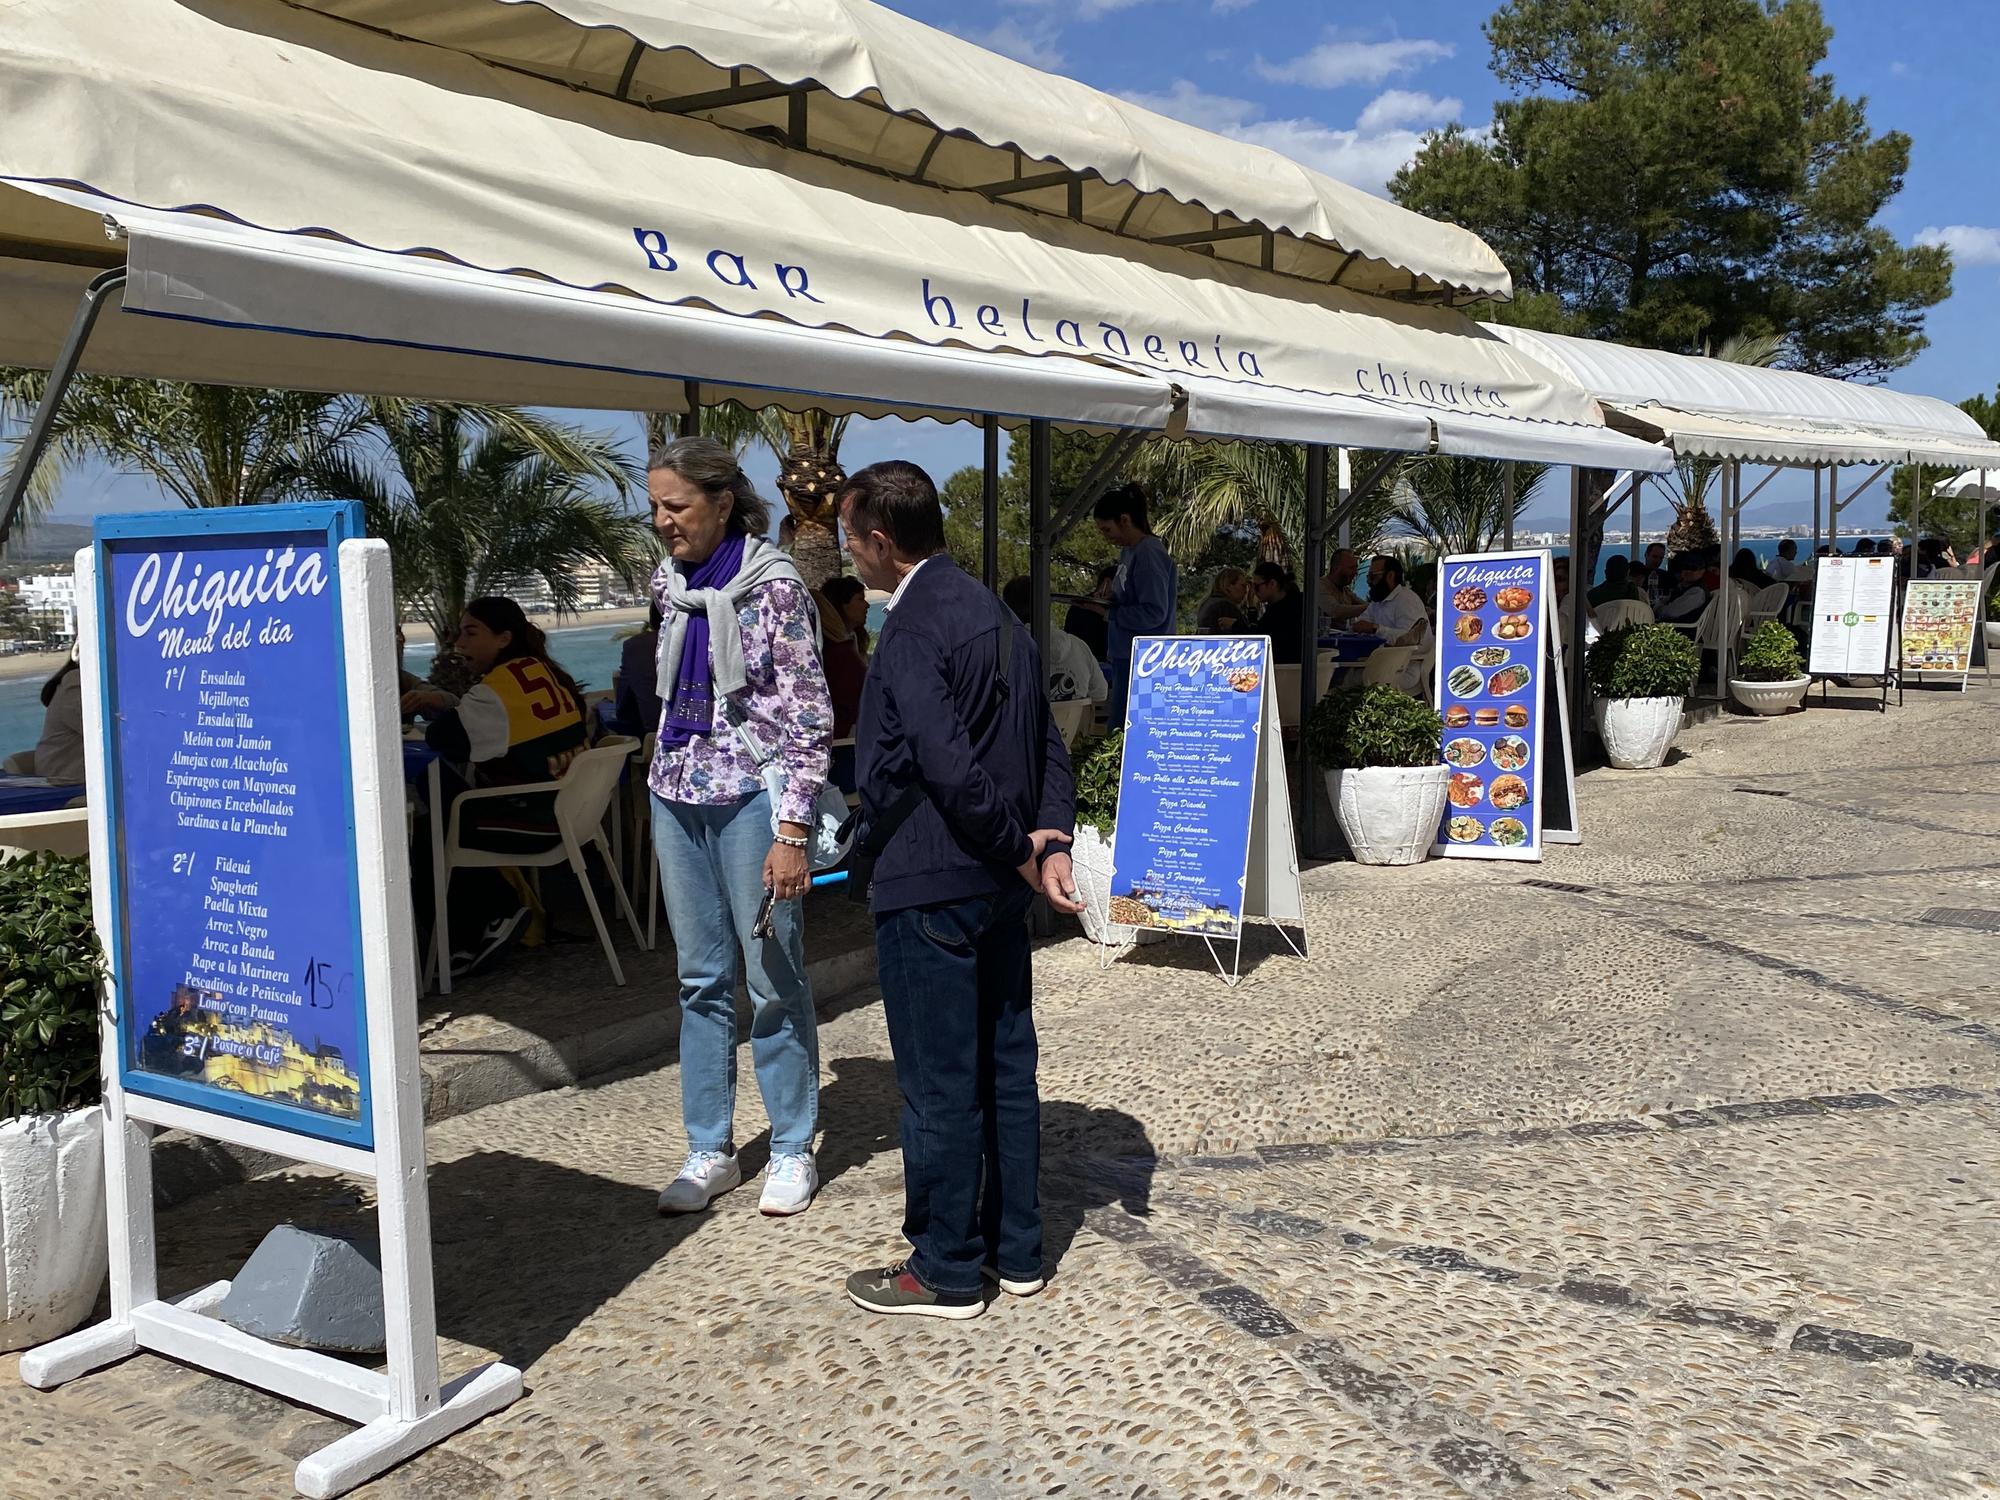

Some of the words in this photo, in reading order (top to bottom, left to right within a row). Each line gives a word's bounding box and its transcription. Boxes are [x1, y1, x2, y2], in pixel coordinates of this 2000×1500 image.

[1356, 363, 1509, 408] chiquita
[1450, 564, 1535, 588] Chiquita
[126, 545, 328, 638] Chiquita
[221, 618, 251, 650] del
[259, 616, 293, 645] día
[1137, 640, 1262, 678] Chiquita
[200, 669, 246, 686] Ensalada
[1211, 662, 1256, 679] Pizzas
[1153, 682, 1172, 693] Pizza
[198, 690, 250, 710] Mejillones
[1171, 705, 1189, 716] Pizza
[1190, 705, 1214, 716] Vegana
[182, 731, 213, 748] Melón
[216, 738, 234, 748] con
[236, 734, 272, 751] Jamón
[1149, 727, 1167, 738] Pizza
[1169, 728, 1202, 737] Prosciutto
[1210, 730, 1245, 741] Formaggio
[170, 750, 208, 770] Almejas
[210, 759, 229, 769] con
[230, 755, 288, 776] Alcachofas
[1146, 750, 1165, 761] Pizza
[1167, 751, 1200, 760] Prosciutto
[1208, 753, 1233, 764] Funghi
[166, 770, 219, 791] Espárragos
[222, 779, 240, 791] con
[243, 776, 296, 796] Mayonesa
[1133, 772, 1151, 784] Pizza
[1153, 773, 1171, 783] Pollo
[1171, 775, 1185, 783] alla
[1187, 776, 1208, 785] Salsa
[170, 790, 222, 810] Chipirones
[224, 795, 294, 816] Encebollados
[1160, 798, 1178, 809] Pizza
[1180, 799, 1206, 809] Diavola
[177, 812, 219, 830] Sardinas
[222, 821, 228, 831] a
[231, 817, 240, 832] la
[243, 818, 288, 837] Plancha
[1153, 821, 1172, 833] Pizza
[1173, 823, 1208, 834] Carbonara
[1158, 846, 1177, 858] Pizza
[1179, 848, 1199, 858] Tonno
[215, 856, 251, 875] Fideuá
[210, 876, 258, 897] Spaghetti
[1146, 869, 1165, 880] Pizza
[1173, 871, 1207, 885] Formaggi
[203, 895, 235, 914] Paella
[237, 899, 268, 918] Mixta
[1144, 893, 1164, 907] Pizza
[205, 916, 234, 935] Arroz
[236, 920, 268, 940] Negro
[202, 936, 230, 954] Arroz
[232, 944, 238, 955] a
[241, 941, 275, 961] Banda
[192, 953, 217, 973] Rape
[219, 962, 225, 972] a
[227, 959, 237, 974] la
[240, 961, 289, 983] Marinera
[184, 971, 234, 993] Pescaditos
[236, 981, 249, 996] de
[251, 983, 302, 1006] Peñíscola
[199, 993, 226, 1011] Lomo
[228, 1004, 247, 1016] con
[250, 1003, 289, 1024] Patatas
[212, 1035, 245, 1056] Postre
[246, 1047, 252, 1057] o
[255, 1044, 280, 1064] Café
